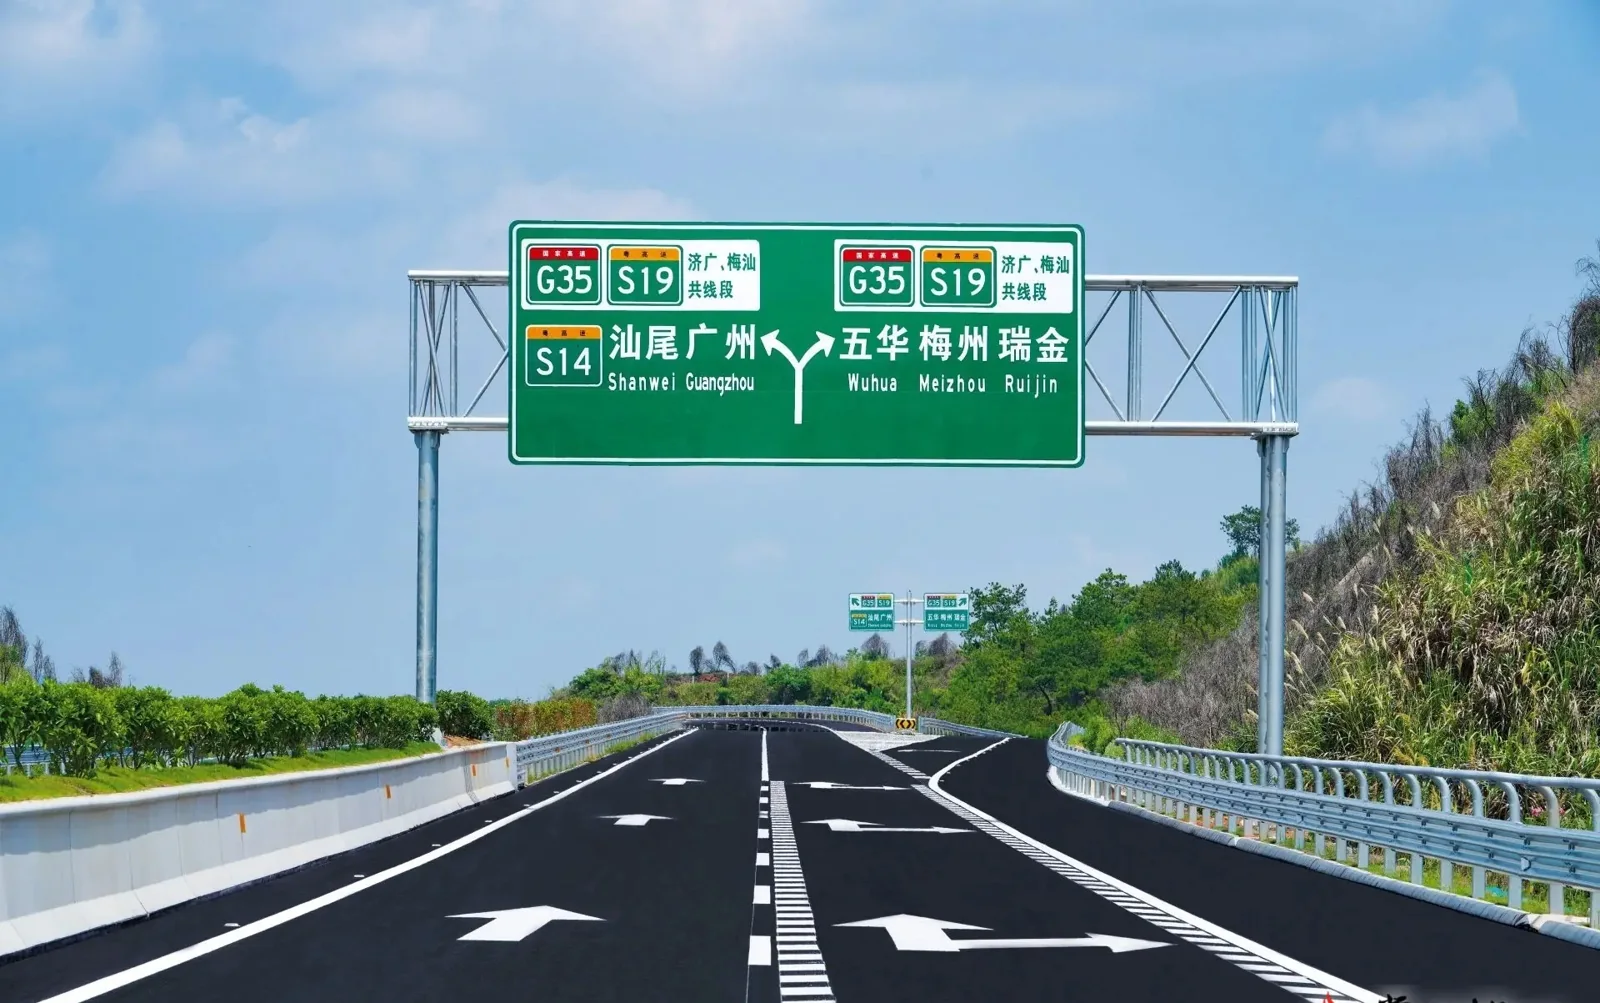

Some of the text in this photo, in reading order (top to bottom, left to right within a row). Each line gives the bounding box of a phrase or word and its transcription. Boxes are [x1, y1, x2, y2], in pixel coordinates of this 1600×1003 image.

[542, 250, 586, 258] 国家高速
[687, 252, 756, 272] 济广、梅汕
[856, 252, 899, 260] 国家高速
[1001, 255, 1070, 274] 济广、梅汕
[537, 265, 593, 294] G35
[617, 265, 674, 295] S19
[687, 280, 734, 299] 共线段
[849, 265, 905, 295] G35
[930, 267, 986, 296] S19
[1001, 282, 1047, 301] 共线段
[536, 347, 592, 376] S14
[608, 371, 755, 397] Shanwei Guangzhou
[847, 373, 1058, 399] Wuhua Meizhou Ruijin
